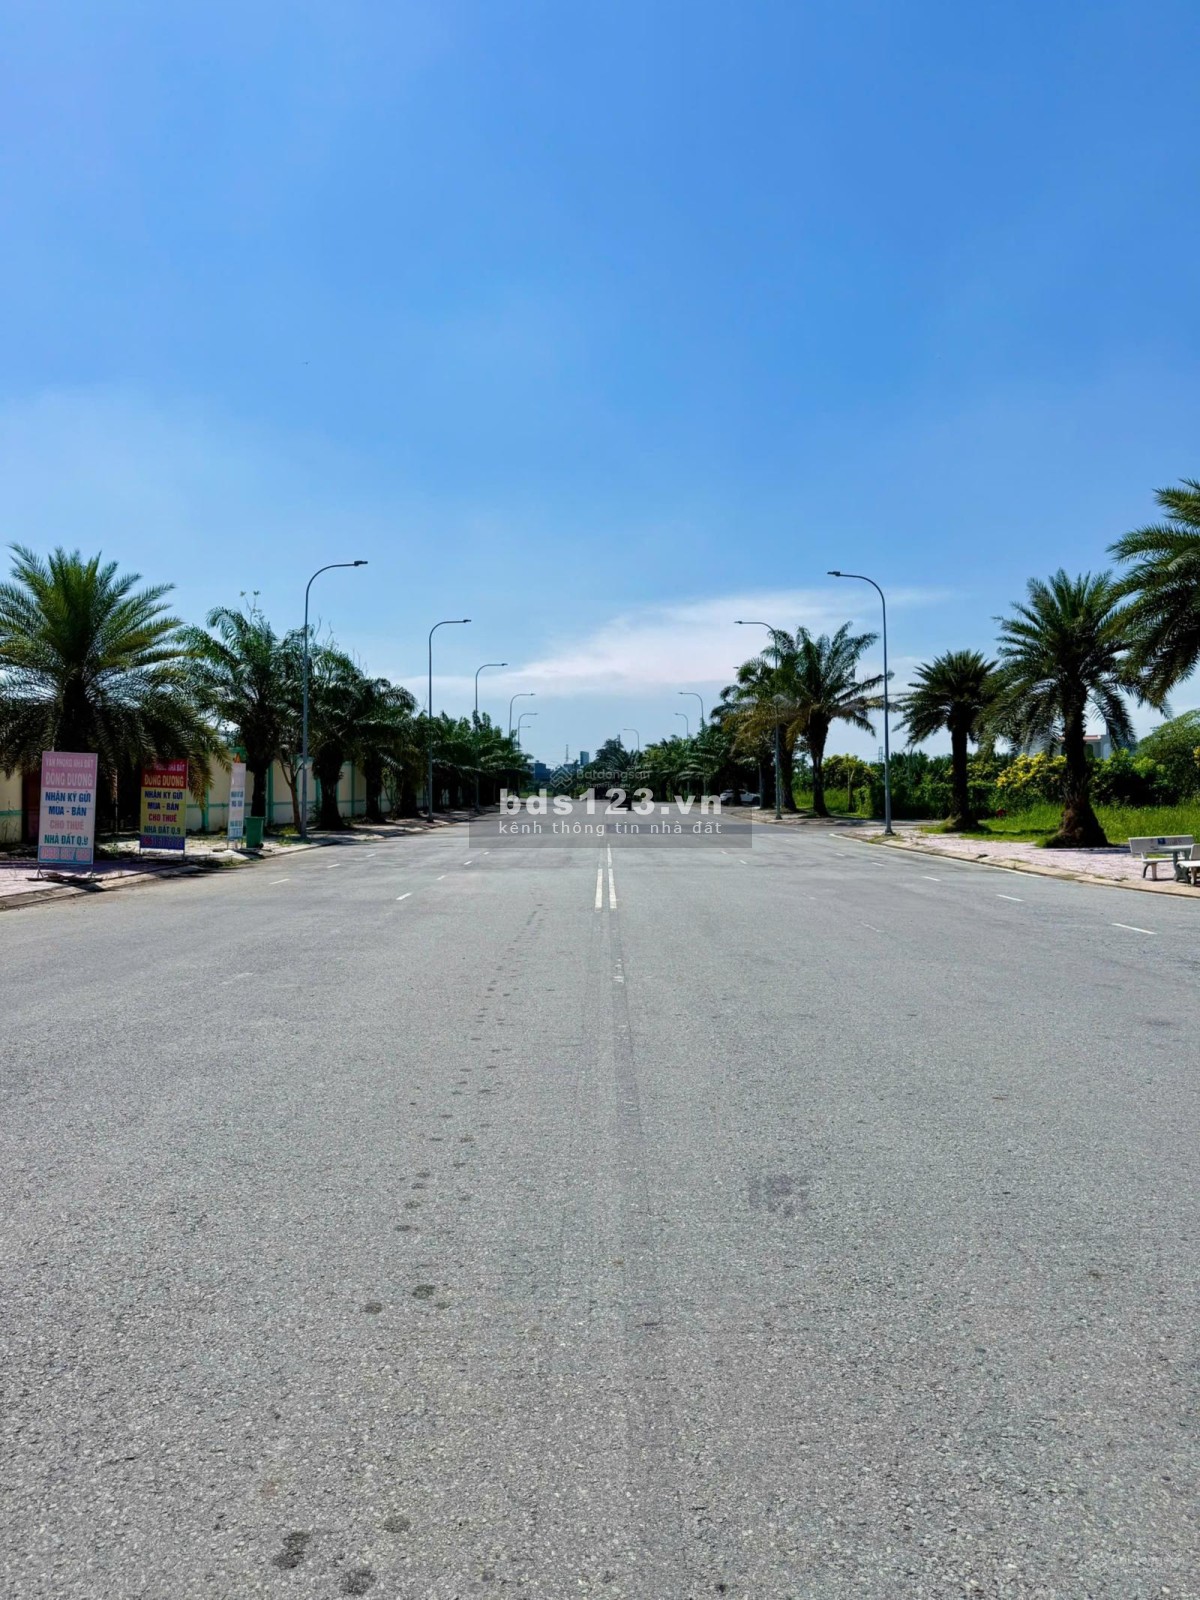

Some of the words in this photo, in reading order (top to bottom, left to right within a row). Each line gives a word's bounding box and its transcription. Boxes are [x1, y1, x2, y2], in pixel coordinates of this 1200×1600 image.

[45, 790, 66, 803] NHẬN
[79, 790, 91, 803] GỬI
[48, 805, 65, 815] MUA
[71, 804, 87, 816] BÁN
[149, 813, 160, 821] CHO
[49, 819, 65, 829] CHO
[44, 832, 59, 844] NHÀ
[61, 832, 75, 845] ĐẤT
